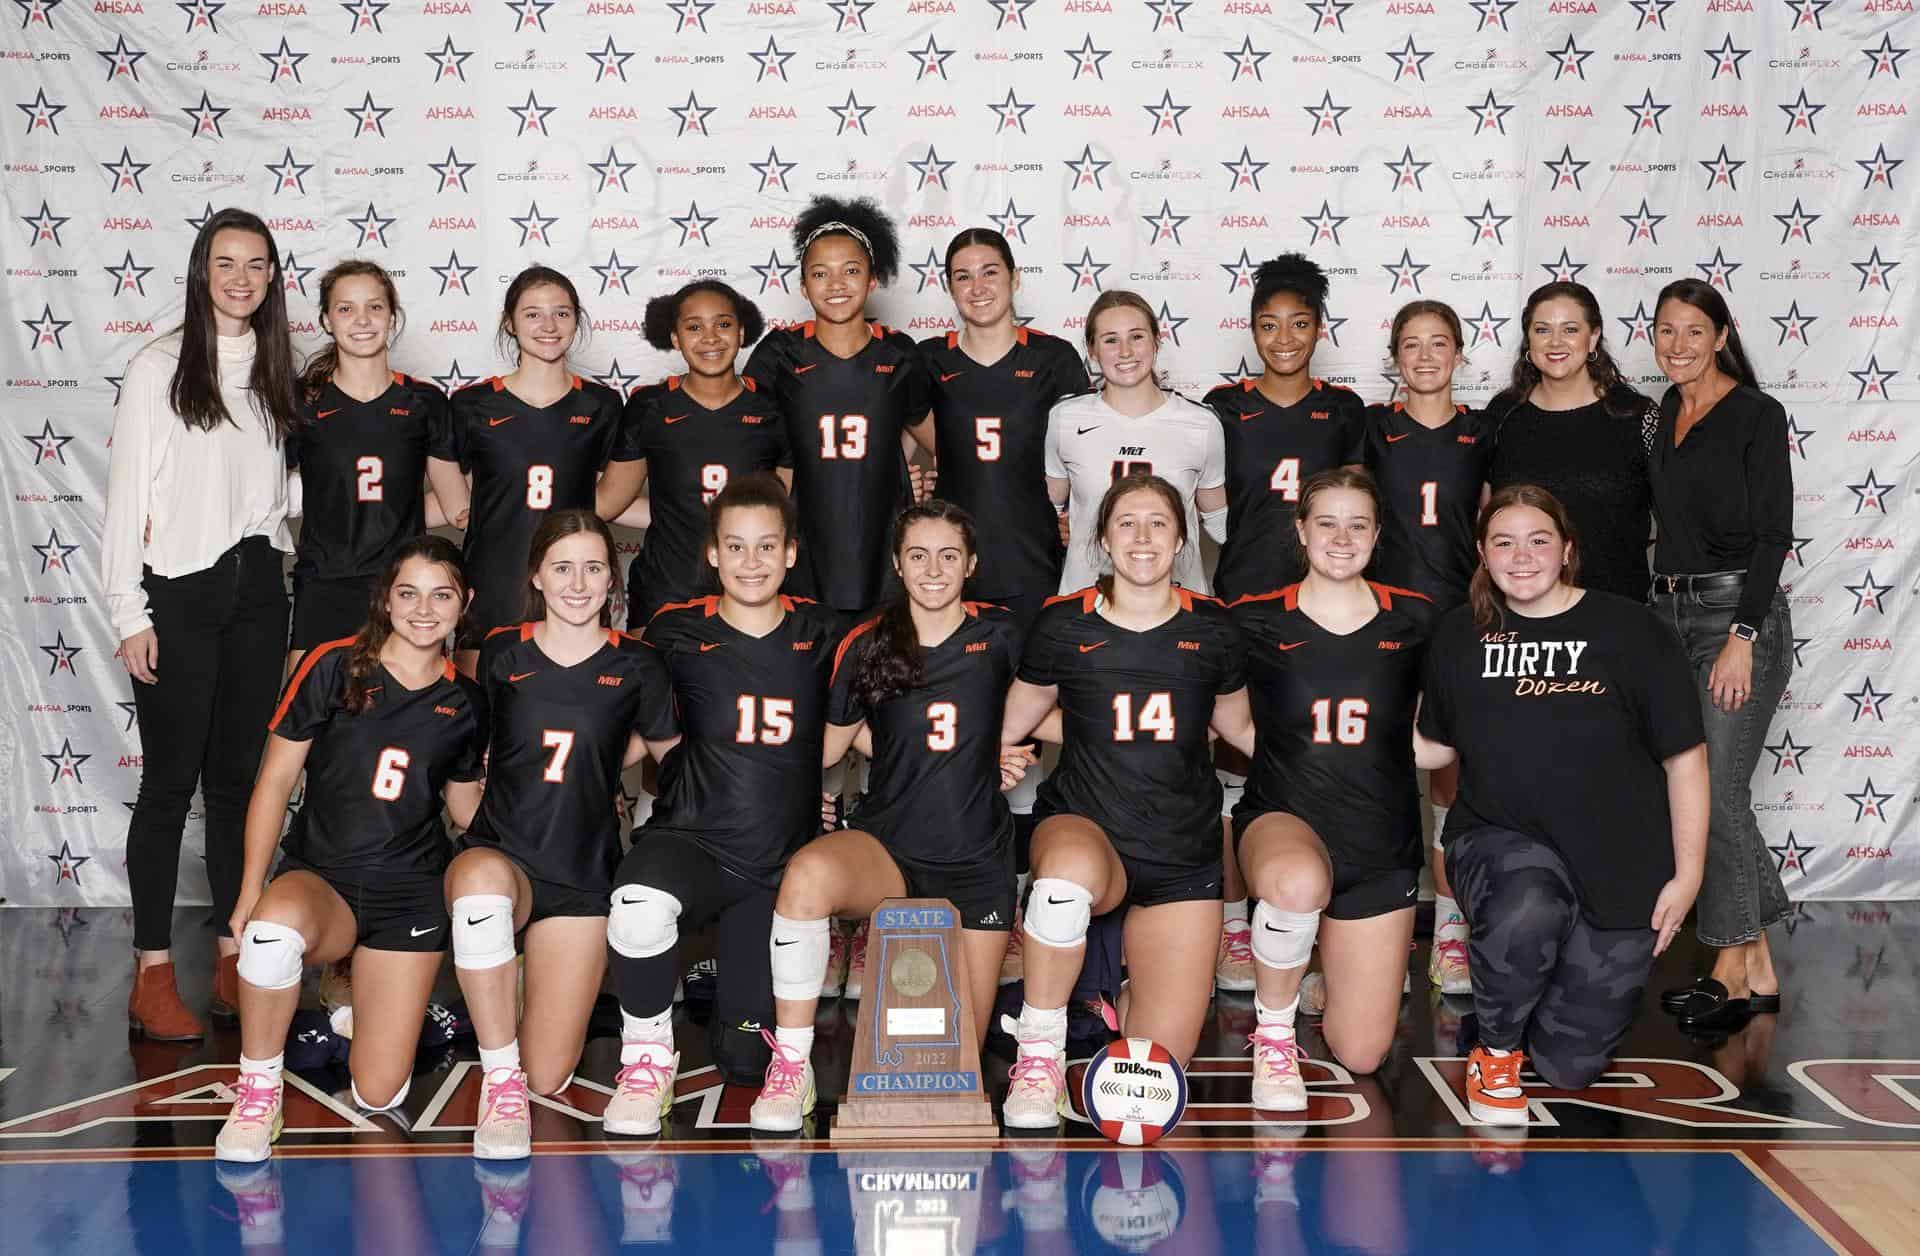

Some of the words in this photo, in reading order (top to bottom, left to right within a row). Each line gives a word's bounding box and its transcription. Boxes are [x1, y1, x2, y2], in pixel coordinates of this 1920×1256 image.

[95, 0, 144, 15] AHSAA
[258, 3, 307, 15] AHSAA
[423, 4, 472, 15] AHSAA
[587, 3, 635, 15] AHSAA
[748, 3, 796, 15] AHSAA
[907, 2, 956, 13] AHSAA
[1064, 2, 1112, 14] AHSAA
[1224, 3, 1272, 15] AHSAA
[1386, 3, 1434, 15] AHSAA
[1549, 2, 1597, 14] AHSAA
[1707, 1, 1753, 14] AHSAA
[1864, 1, 1914, 14] AHSAA
[100, 106, 149, 119] AHSAA
[262, 107, 311, 121] AHSAA
[426, 107, 474, 120] AHSAA
[589, 107, 637, 120] AHSAA
[749, 107, 797, 120] AHSAA
[908, 106, 955, 118] AHSAA
[1064, 105, 1112, 118] AHSAA
[1222, 106, 1270, 120] AHSAA
[1384, 107, 1432, 119] AHSAA
[1546, 105, 1593, 118] AHSAA
[1702, 105, 1748, 118] AHSAA
[1857, 104, 1907, 116] AHSAA
[103, 218, 152, 231] AHSAA
[429, 217, 476, 230] AHSAA
[591, 217, 639, 230] AHSAA
[909, 215, 956, 228] AHSAA
[1064, 215, 1111, 228] AHSAA
[1221, 216, 1268, 229] AHSAA
[1382, 216, 1430, 229] AHSAA
[1544, 216, 1590, 228] AHSAA
[1697, 215, 1743, 227] AHSAA
[1853, 214, 1900, 227] AHSAA
[105, 320, 154, 333] AHSAA
[430, 320, 478, 333] AHSAA
[908, 317, 956, 329] AHSAA
[1849, 315, 1898, 329] AHSAA
[818, 414, 868, 459] 13
[975, 416, 1002, 462] 5
[1848, 430, 1896, 442] AHSAA
[356, 455, 384, 501] 2
[701, 463, 729, 505] 9
[1270, 457, 1300, 502] 4
[526, 464, 554, 510] 8
[1420, 481, 1439, 526] 1
[1845, 537, 1894, 550] AHSAA
[1843, 638, 1892, 650] AHSAA
[1481, 641, 1588, 678] DIRTY
[1515, 677, 1608, 696] Dozen
[735, 694, 795, 746] 15
[1112, 692, 1176, 742] 14
[1311, 698, 1370, 745] 16
[926, 702, 959, 752] 3
[542, 729, 576, 783] 7
[1843, 746, 1893, 758] AHSAA
[372, 747, 410, 801] 6
[1846, 848, 1893, 860] AHSAA
[884, 911, 946, 927] STATE
[914, 1053, 947, 1066] 2022
[1113, 1062, 1162, 1080] Wilson
[861, 1073, 970, 1091] CHAMPION
